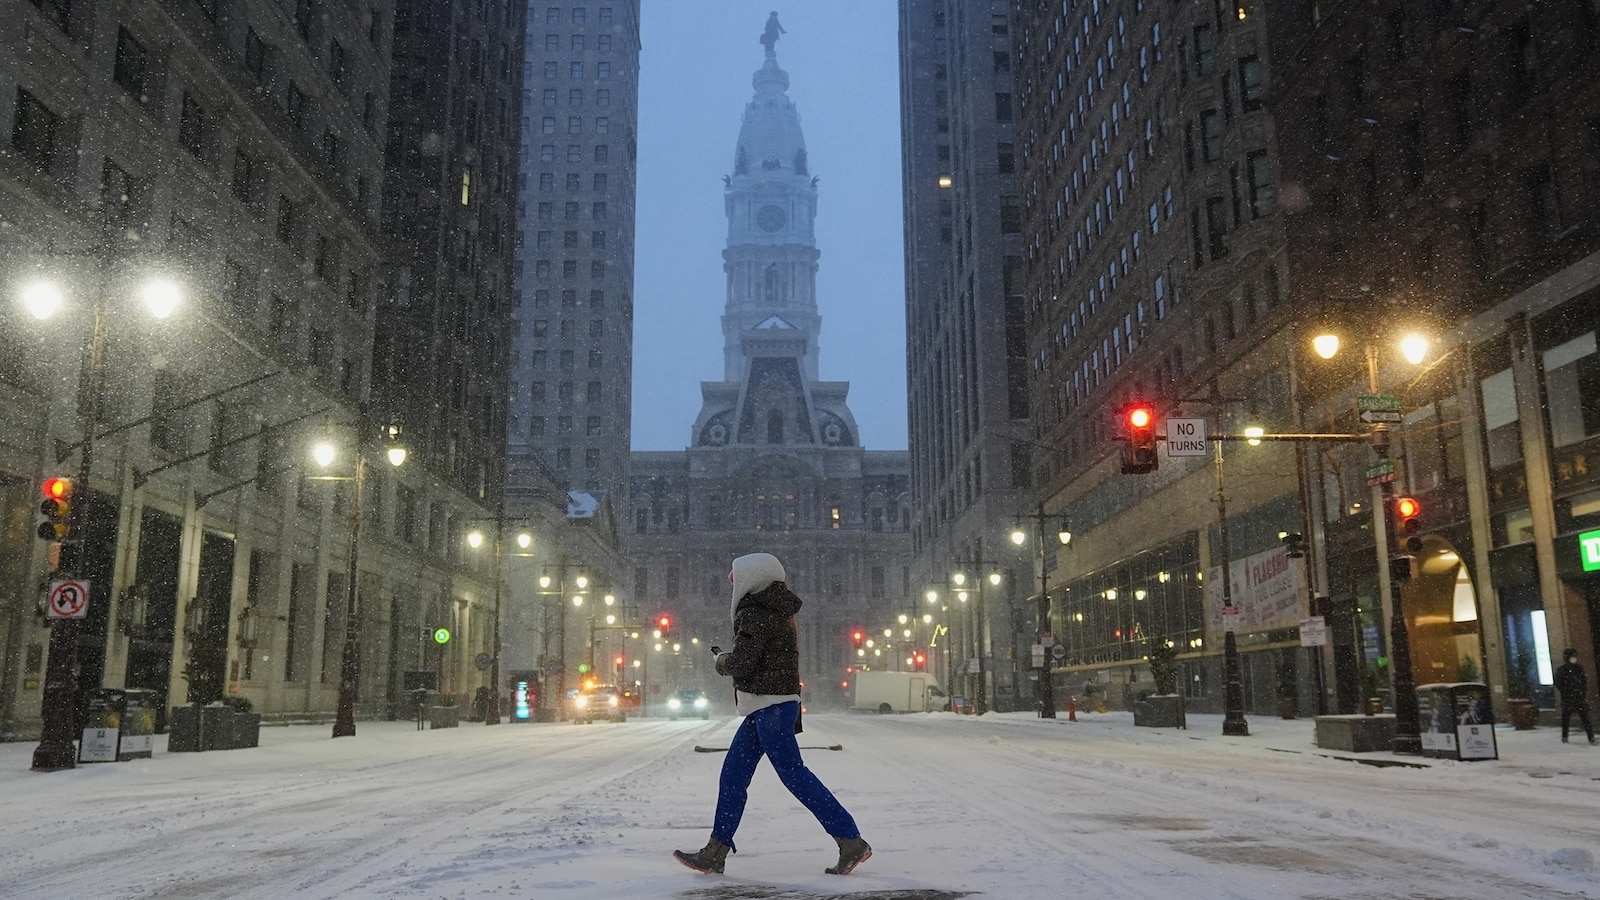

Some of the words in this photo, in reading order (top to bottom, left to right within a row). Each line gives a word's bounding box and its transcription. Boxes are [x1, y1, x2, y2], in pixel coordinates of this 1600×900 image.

[1358, 398, 1392, 409] SANSOM
[1177, 423, 1195, 435] NO
[1169, 440, 1205, 451] TURNS
